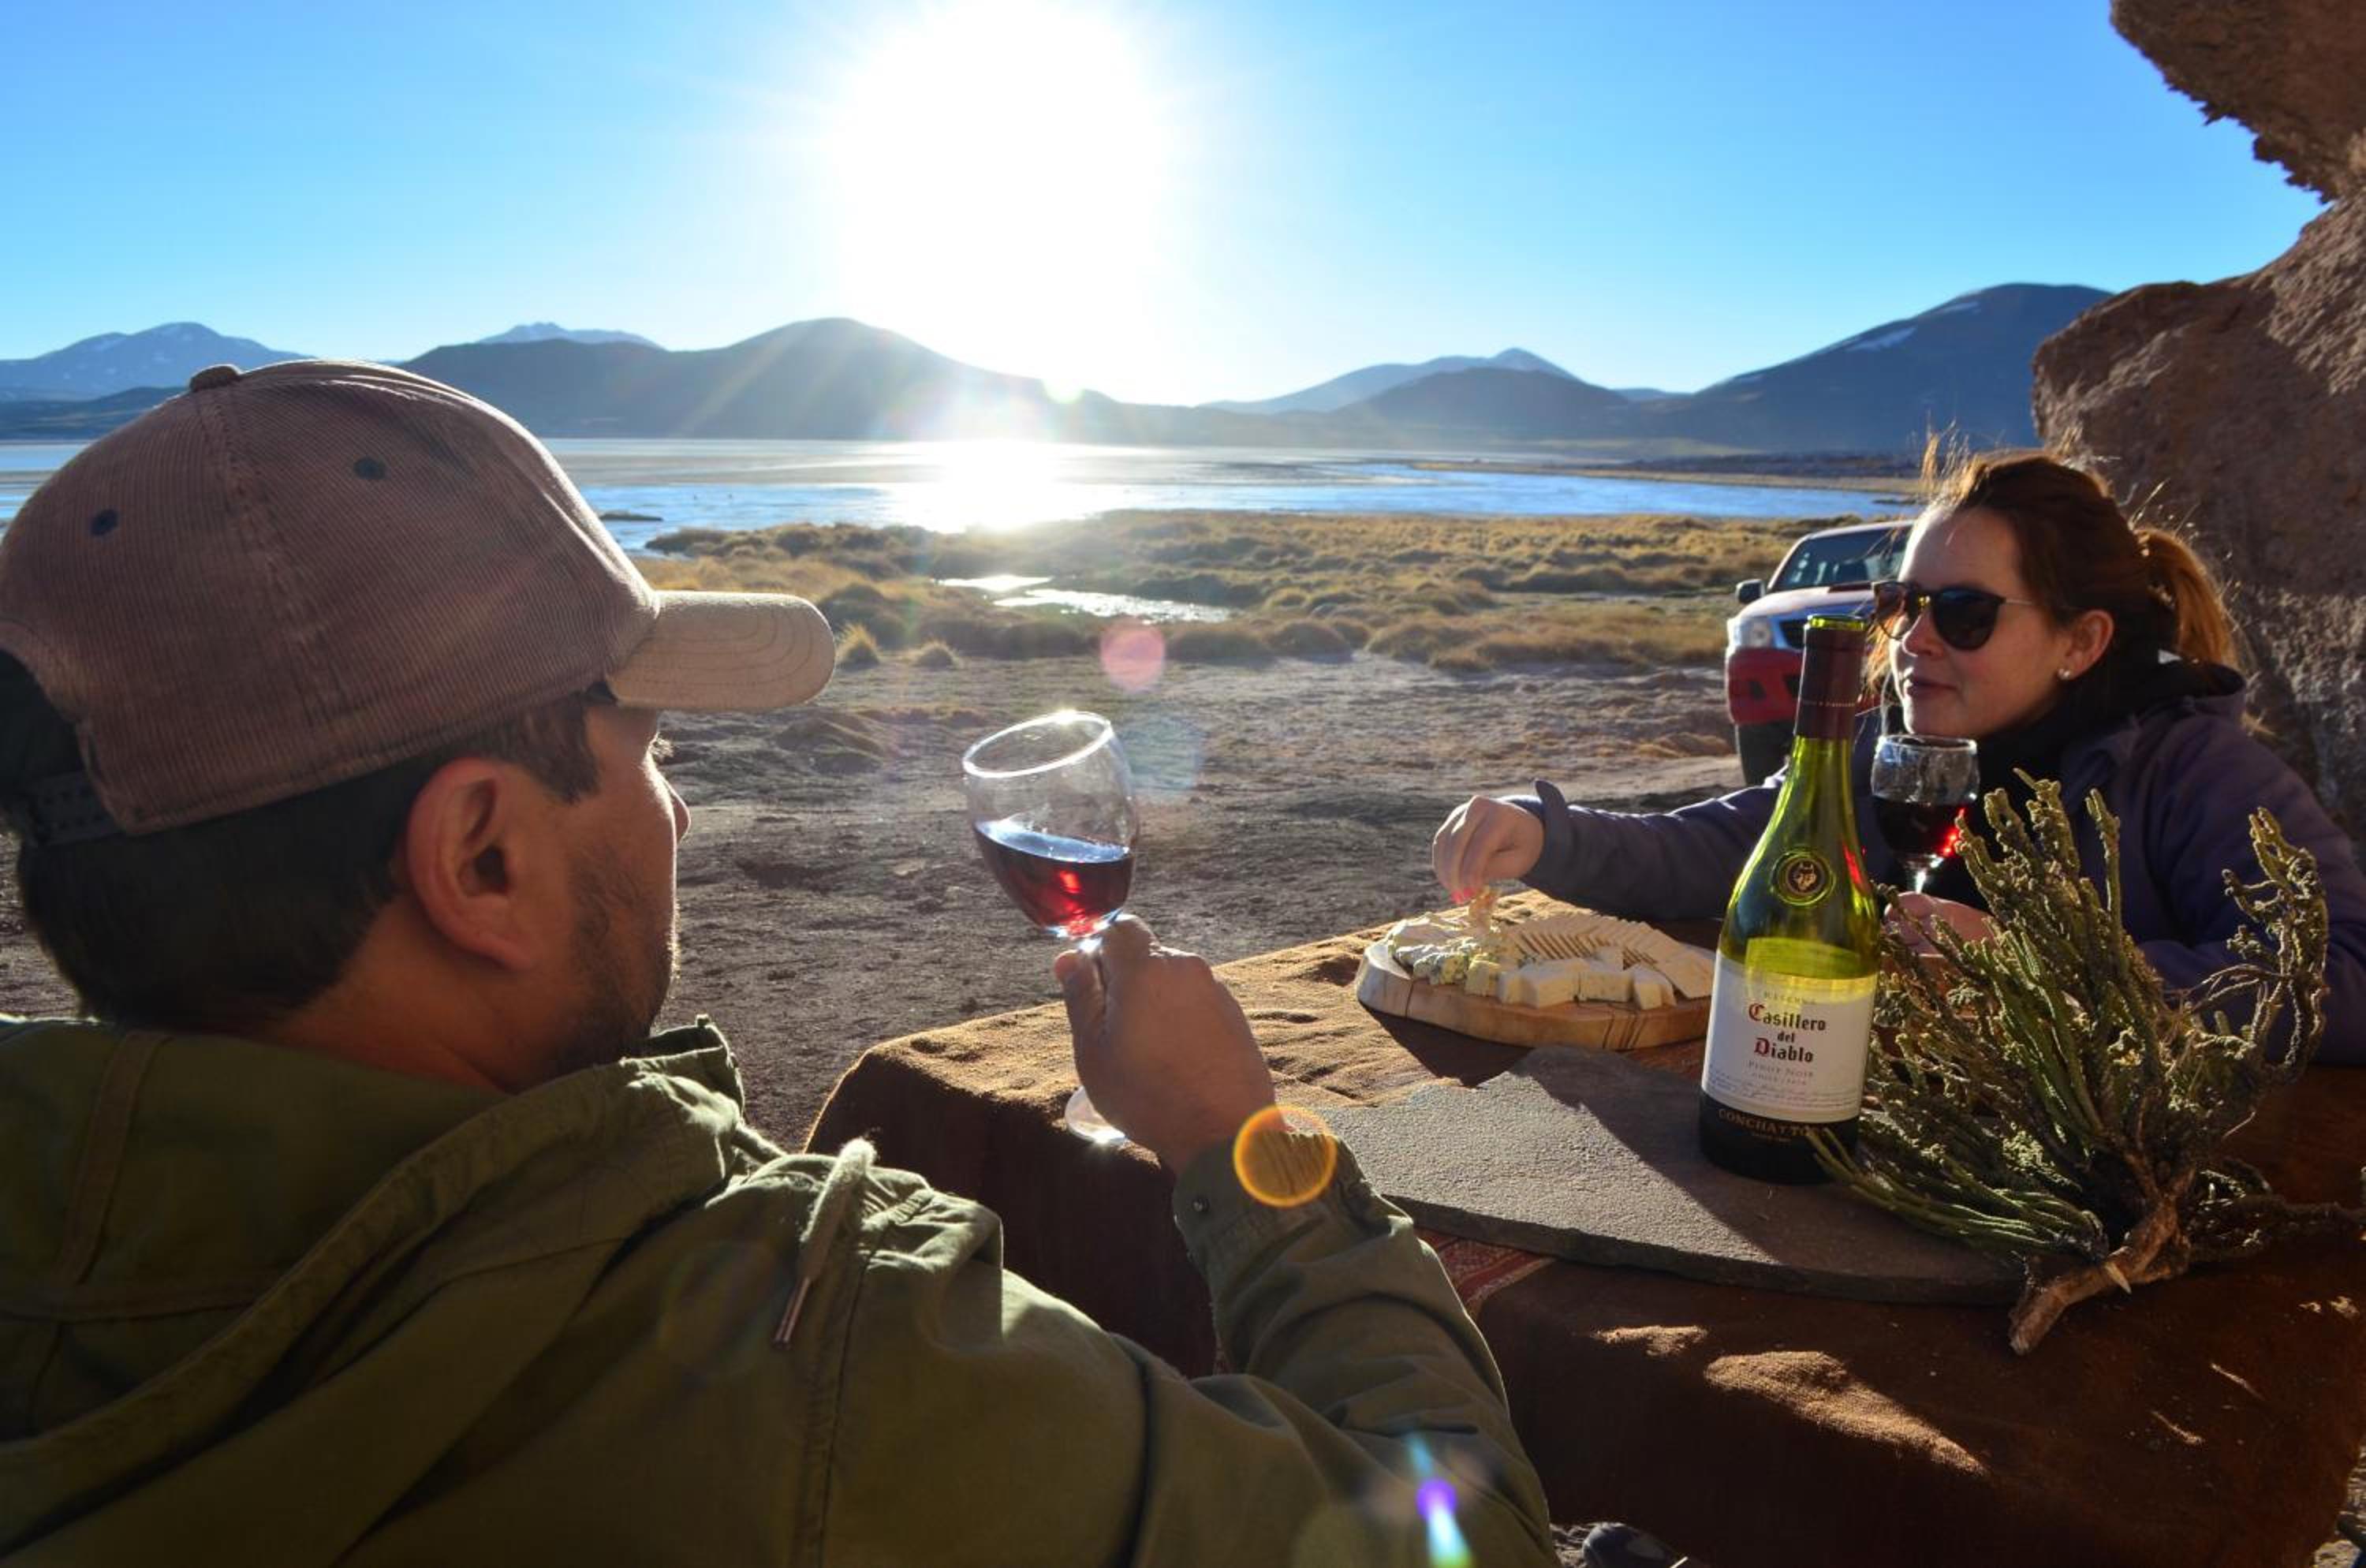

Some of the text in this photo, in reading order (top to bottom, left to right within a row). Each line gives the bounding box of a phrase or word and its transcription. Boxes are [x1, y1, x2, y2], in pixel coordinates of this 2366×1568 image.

[1748, 1002, 1827, 1031] Casillero
[1754, 1037, 1814, 1063] Diablo
[1777, 1031, 1796, 1043] del
[1719, 1108, 1778, 1134] CONCHA
